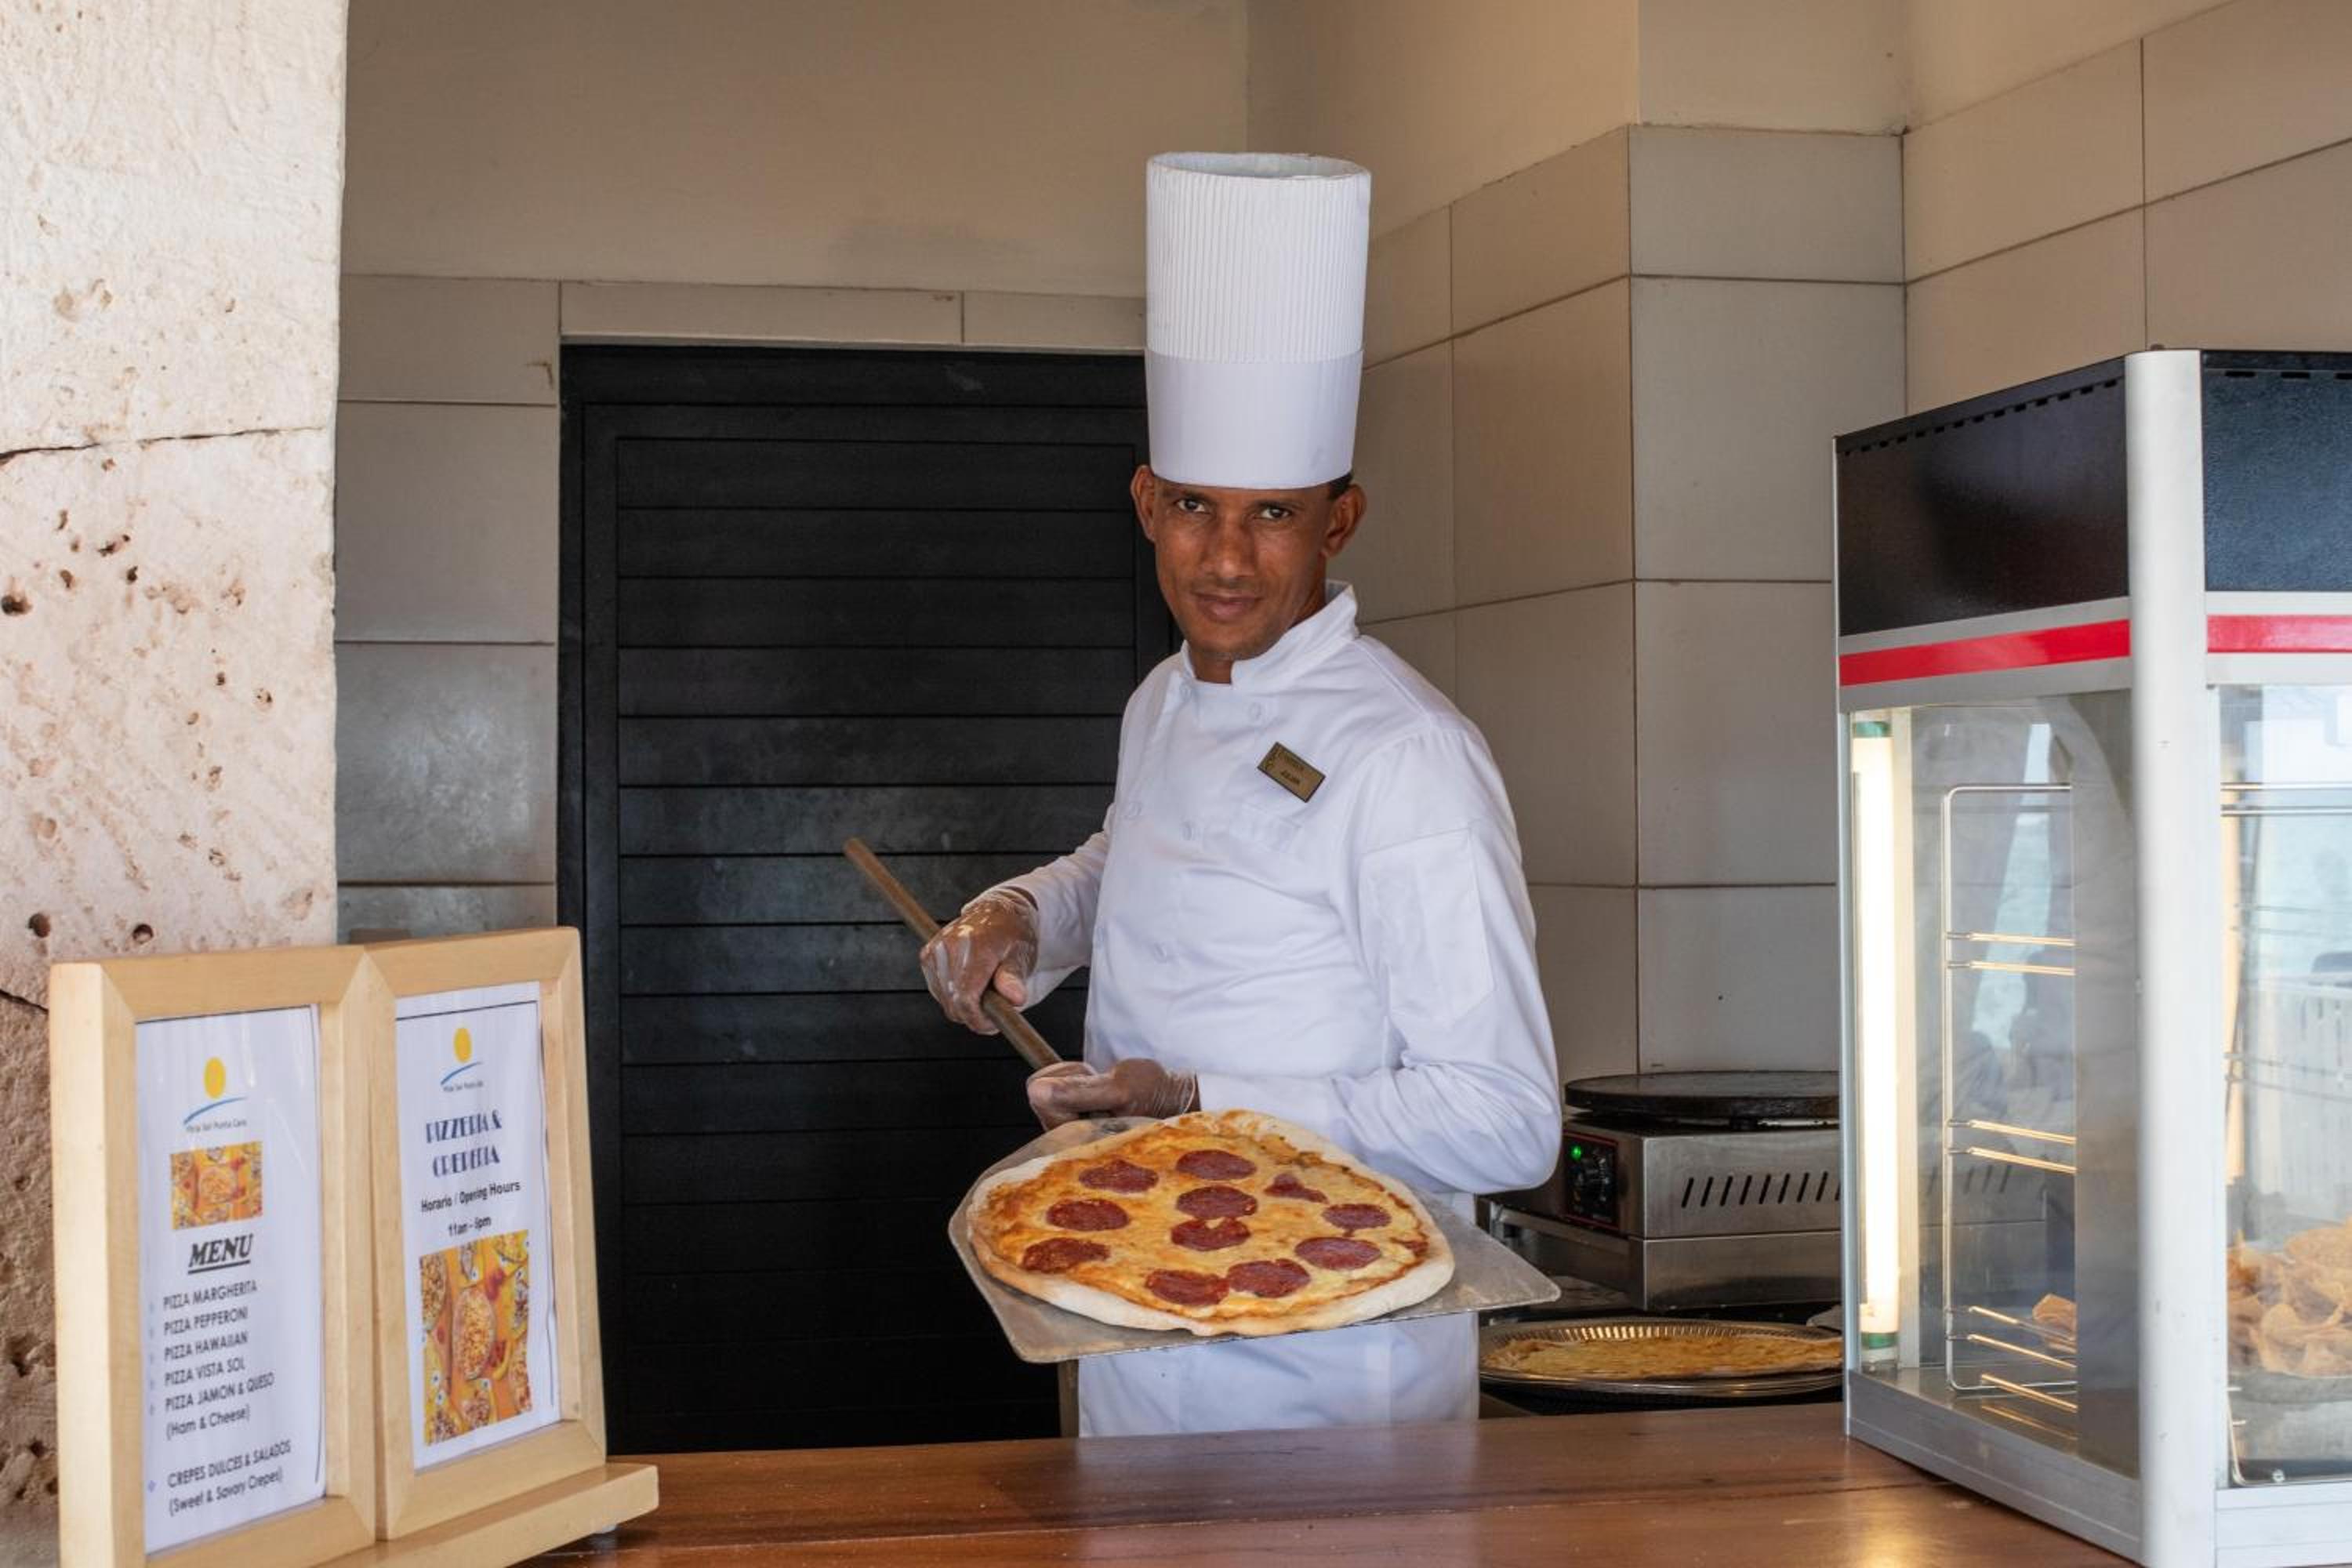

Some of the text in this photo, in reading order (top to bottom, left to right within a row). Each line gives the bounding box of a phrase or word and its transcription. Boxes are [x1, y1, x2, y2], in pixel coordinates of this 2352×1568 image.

[491, 1109, 503, 1130] &
[421, 1196, 452, 1212] Horario
[459, 1187, 488, 1204] Opening
[488, 1181, 521, 1196] Hours
[188, 1232, 254, 1268] MENU
[163, 1280, 258, 1311] PIZZA MARGHERITA
[164, 1306, 249, 1335] PIZZA PEPPERONI
[164, 1344, 192, 1361] PIZZA
[165, 1356, 246, 1387] PIZZA VISTA SOL
[165, 1372, 275, 1412] PIZZA JAMON & QUESO
[166, 1403, 250, 1441] (Ham & Cheese)
[167, 1440, 292, 1488] CREPES DULCES & SALADOS
[169, 1466, 283, 1517] (Sweet & Savory Crepes)
